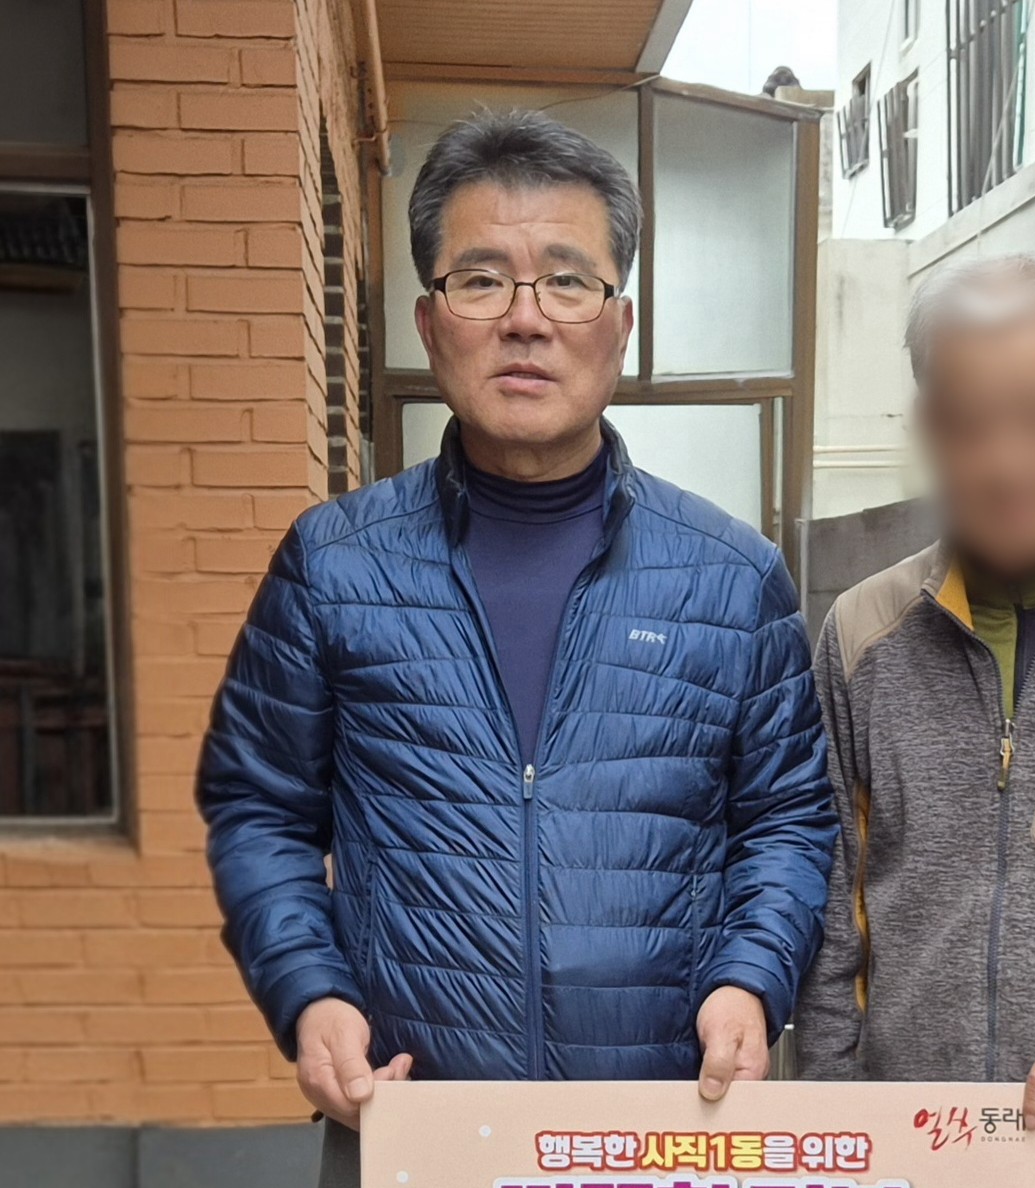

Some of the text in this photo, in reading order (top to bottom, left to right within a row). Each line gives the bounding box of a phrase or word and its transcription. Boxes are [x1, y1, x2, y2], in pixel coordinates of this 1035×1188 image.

[979, 1108, 1027, 1134] 동래
[537, 1132, 870, 1169] 행복한 사직1동을 위한
